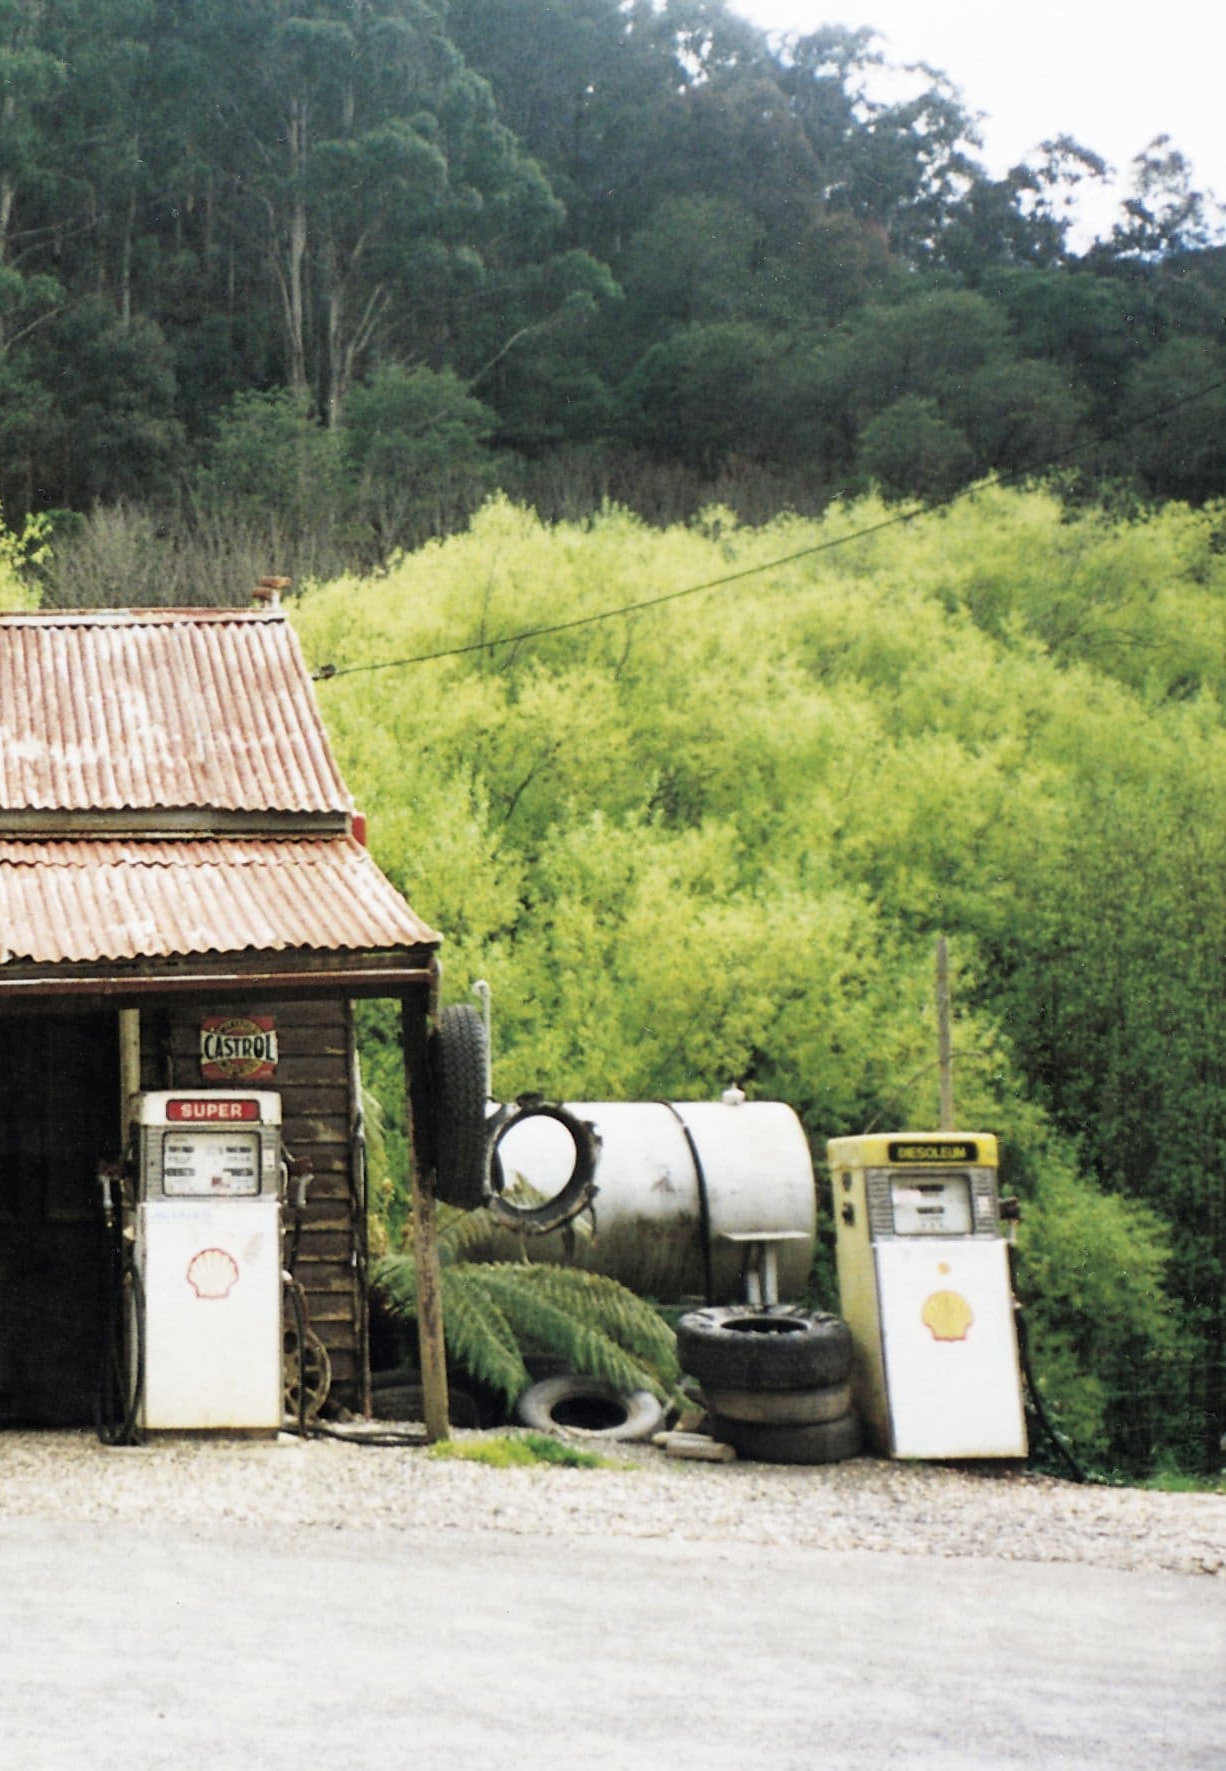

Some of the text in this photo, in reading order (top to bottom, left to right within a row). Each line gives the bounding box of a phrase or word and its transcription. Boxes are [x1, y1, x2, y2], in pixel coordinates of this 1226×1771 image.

[204, 1033, 275, 1061] CASTROL
[181, 1103, 242, 1117] SUPER
[898, 1146, 967, 1159] DIESOLEUM
